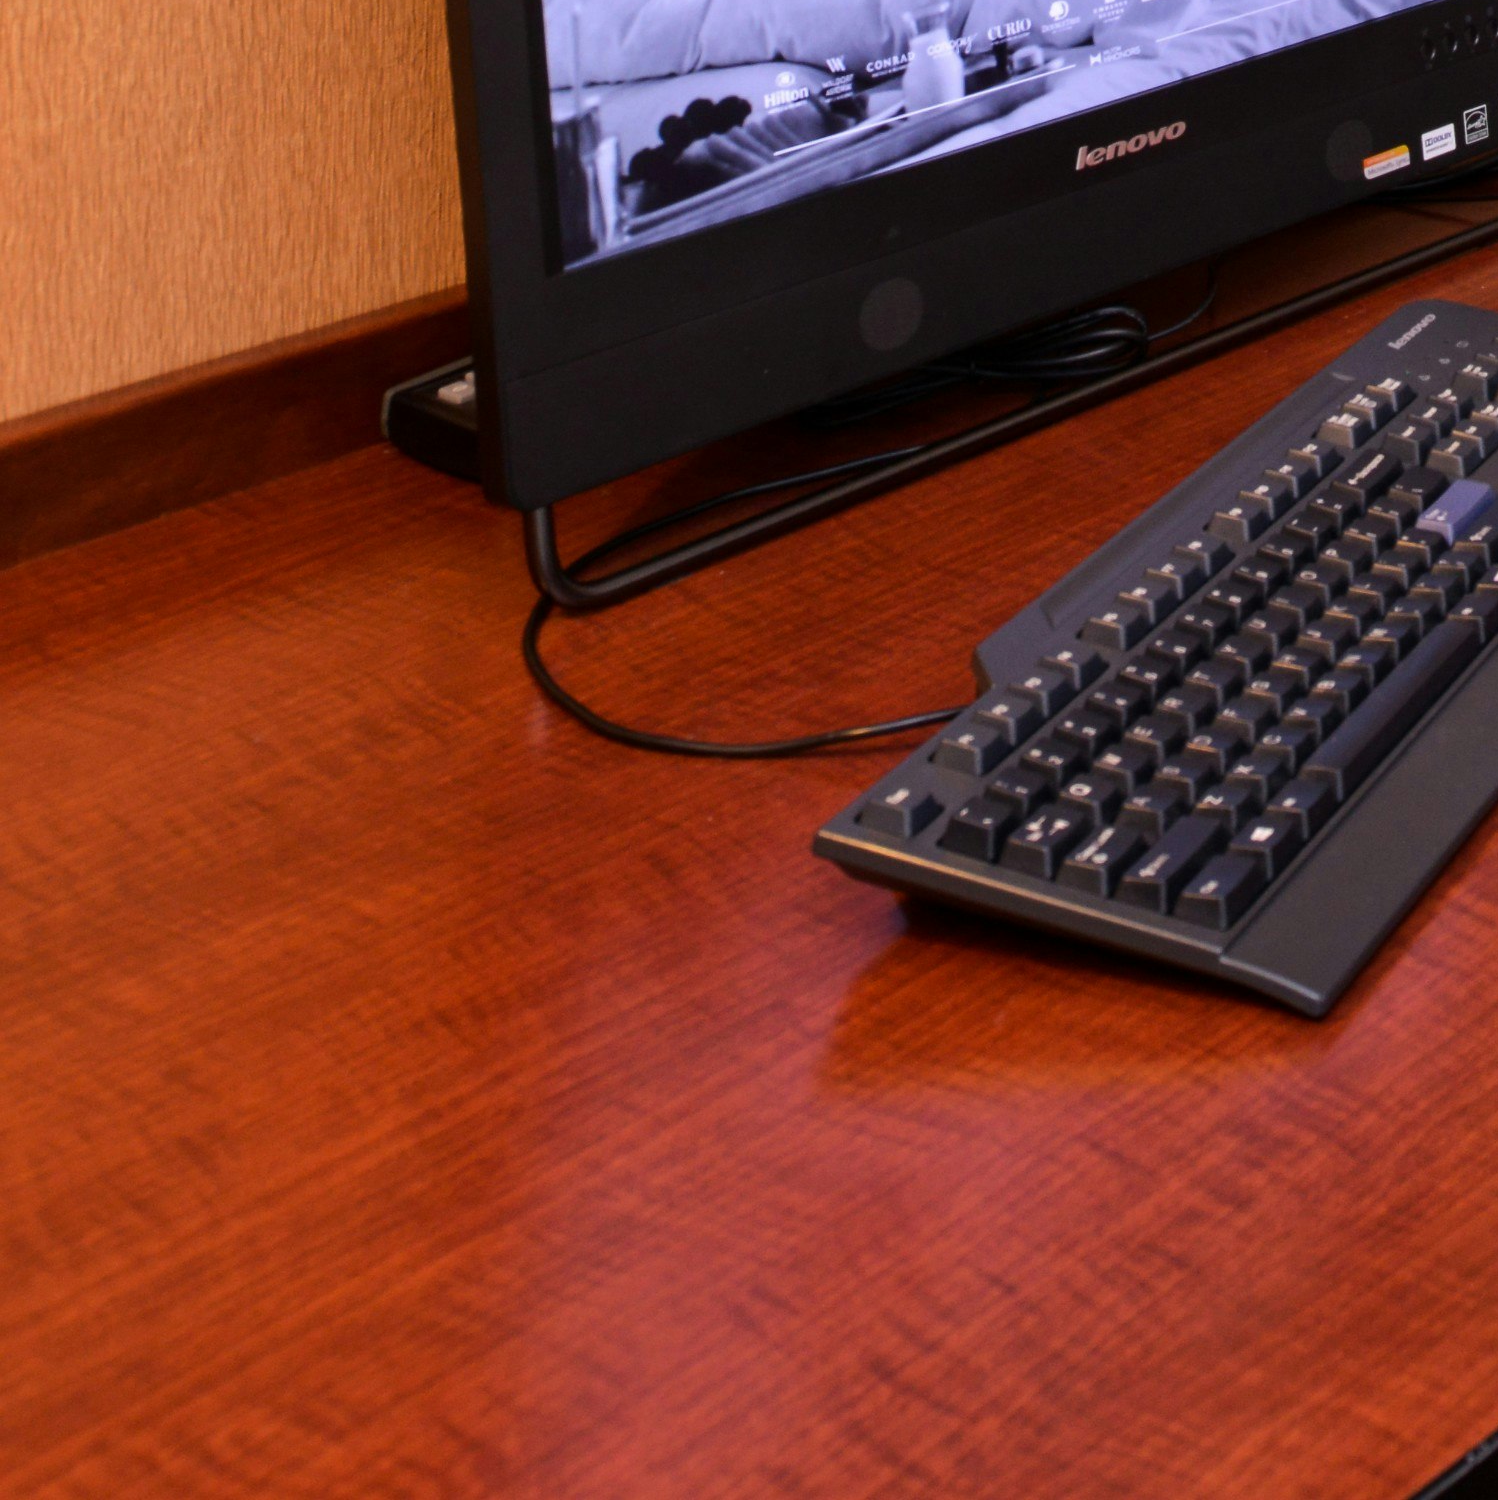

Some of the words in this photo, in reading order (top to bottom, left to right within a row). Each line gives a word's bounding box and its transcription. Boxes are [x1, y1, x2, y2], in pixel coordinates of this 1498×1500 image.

[987, 18, 1032, 41] CURIO
[866, 51, 916, 73] CONRAD
[763, 86, 810, 108] Hilton
[1075, 121, 1187, 171] lenovo
